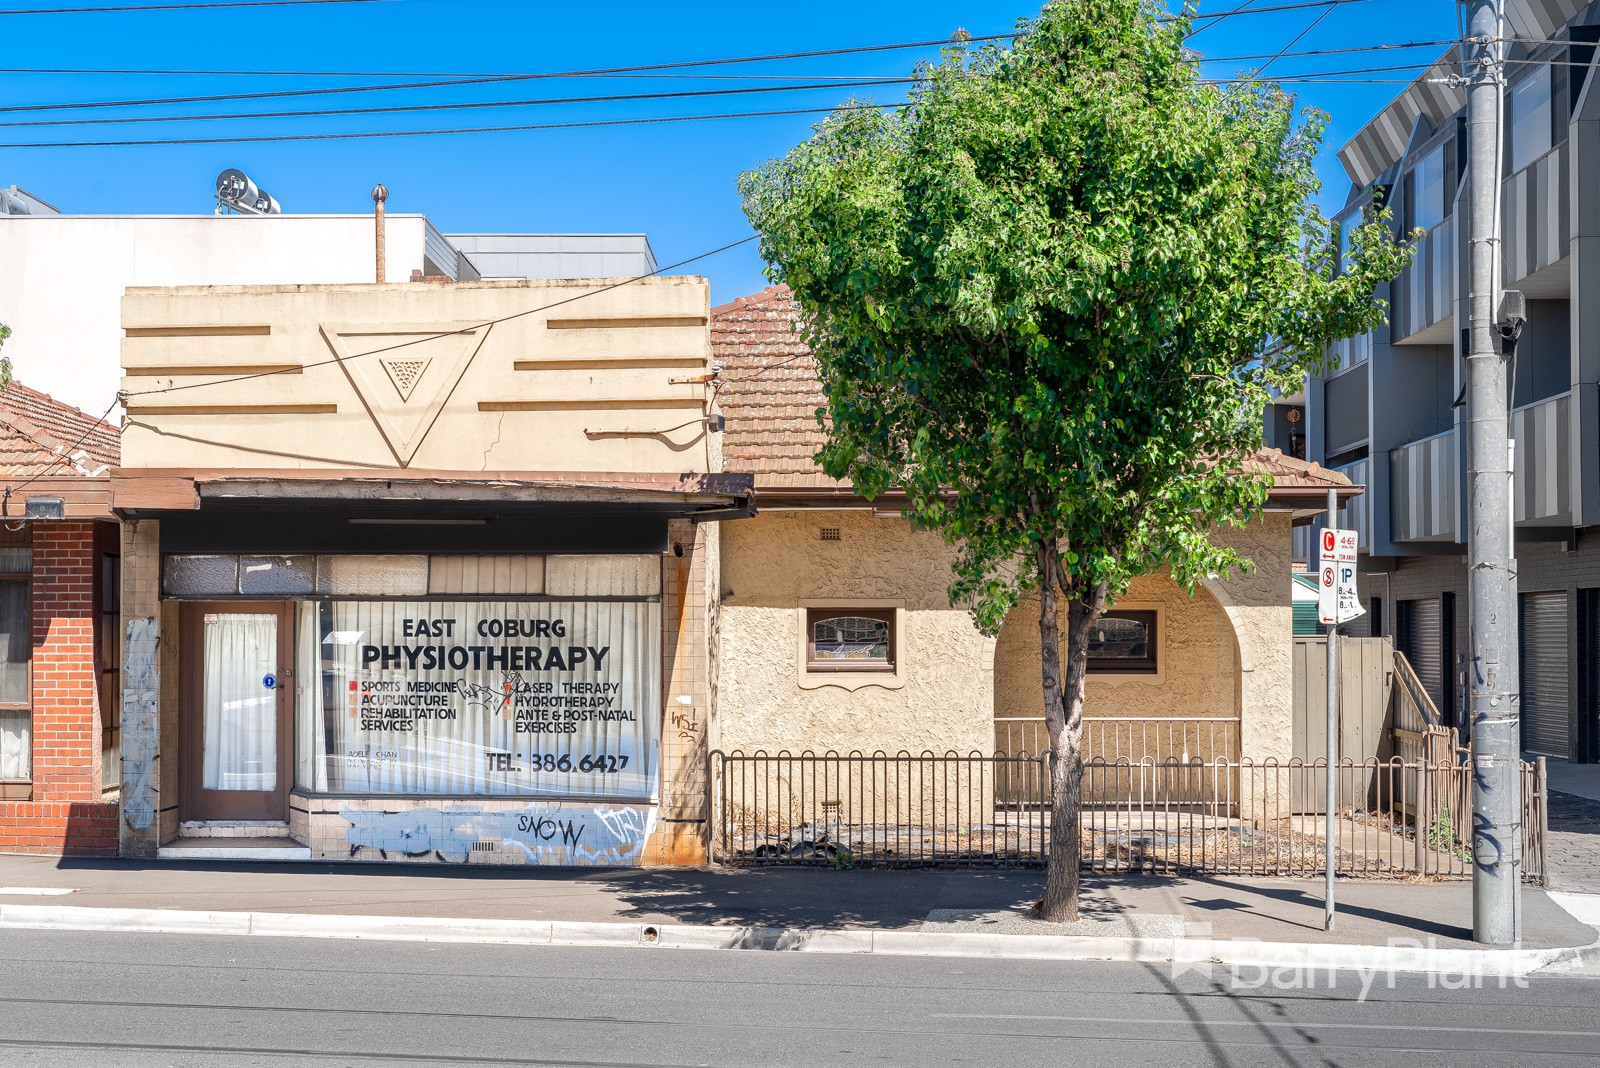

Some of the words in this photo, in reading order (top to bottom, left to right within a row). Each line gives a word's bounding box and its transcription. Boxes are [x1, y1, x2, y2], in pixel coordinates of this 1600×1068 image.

[1341, 568, 1353, 583] 1P
[402, 619, 456, 638] EAST
[477, 619, 566, 638] COBURG
[361, 645, 610, 671] PHYSIOTHERAPY
[361, 681, 401, 692] SPORTS
[407, 682, 458, 693] MEDICINE
[515, 682, 553, 693] LASER
[562, 683, 619, 694] THERAPY
[361, 694, 448, 706] ACUPUNCTURE
[515, 696, 615, 707] HYDROTHERAPY
[360, 708, 456, 719] REHABILITATION
[516, 710, 548, 720] ANTE
[552, 711, 562, 721] &
[563, 710, 637, 721] POST-NATAL
[360, 720, 413, 731] SERVICES
[515, 722, 577, 733] EXERCISES
[486, 753, 522, 772] TEL:
[532, 753, 629, 773] 386.6427
[518, 816, 585, 857] SNOW
